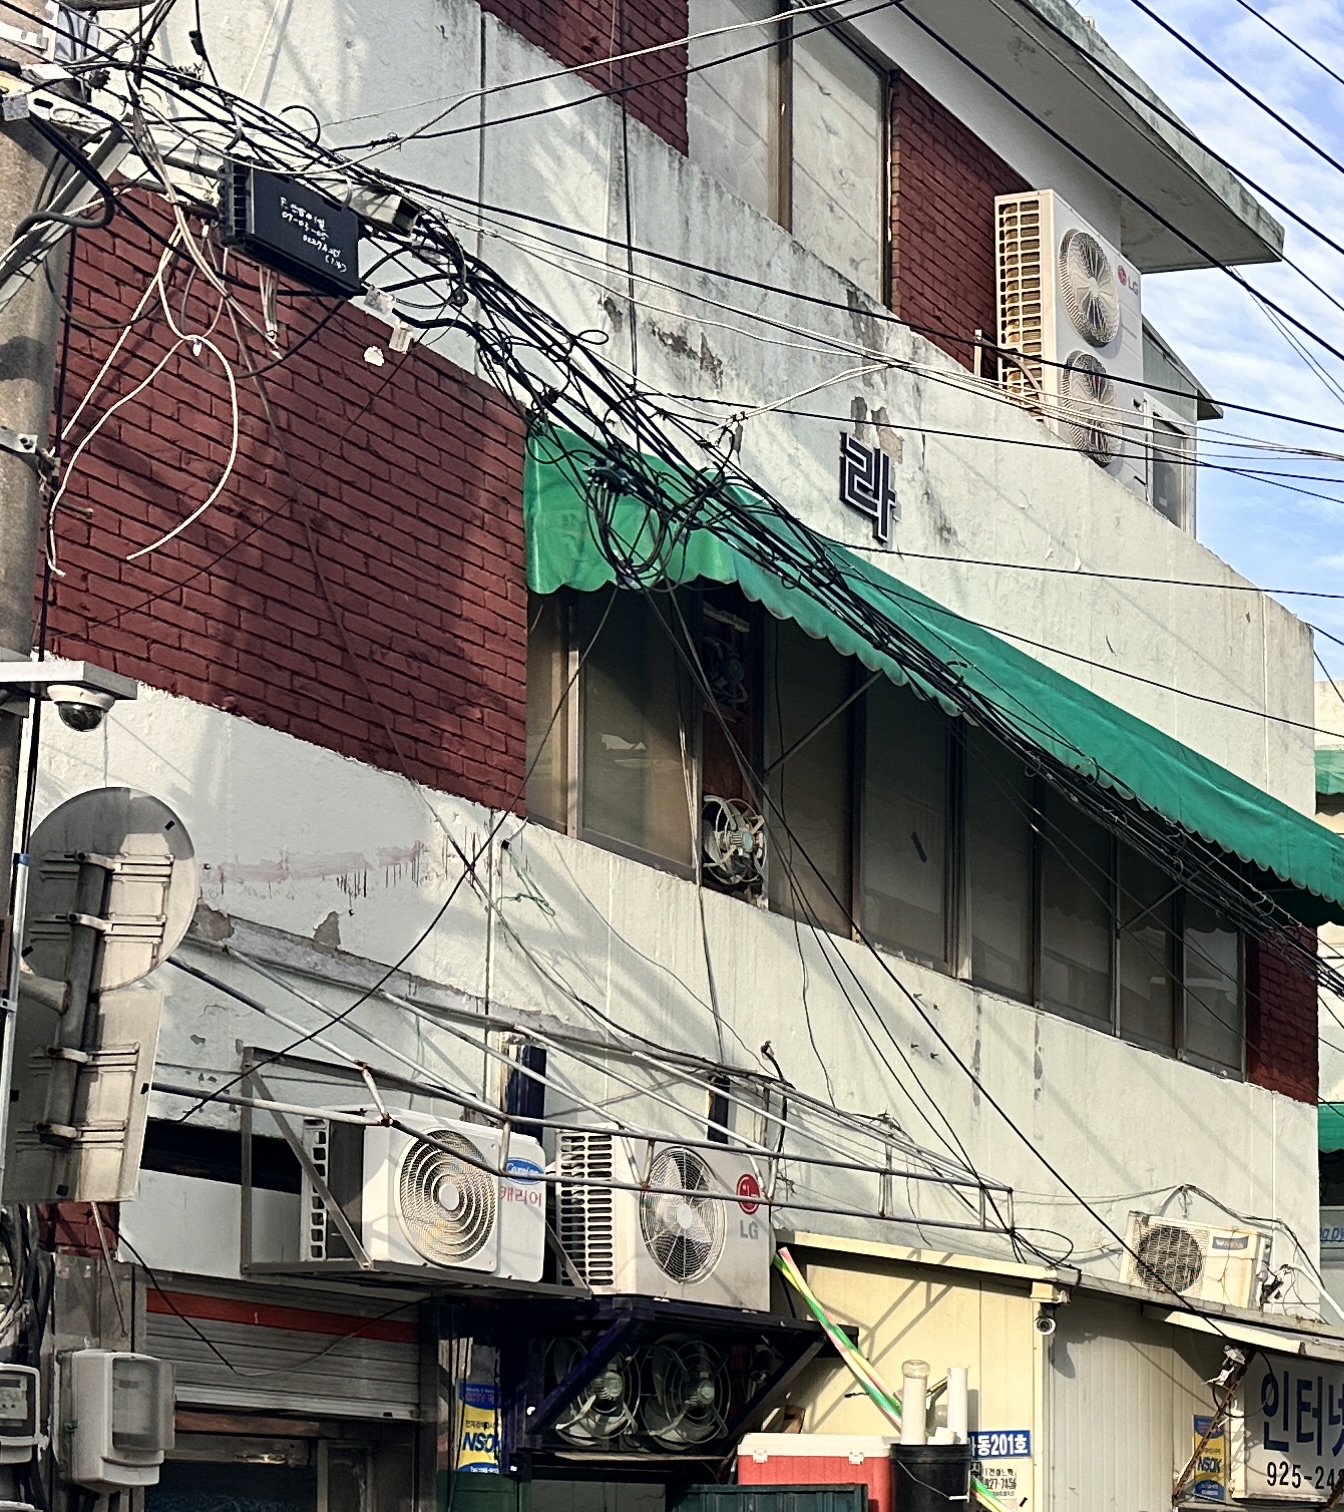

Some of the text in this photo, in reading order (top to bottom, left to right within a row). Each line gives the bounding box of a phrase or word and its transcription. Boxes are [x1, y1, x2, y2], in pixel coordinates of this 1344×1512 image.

[839, 432, 896, 542] 라
[500, 1186, 542, 1207] 캐리어
[739, 1219, 759, 1240] LG
[462, 1433, 501, 1453] NSO
